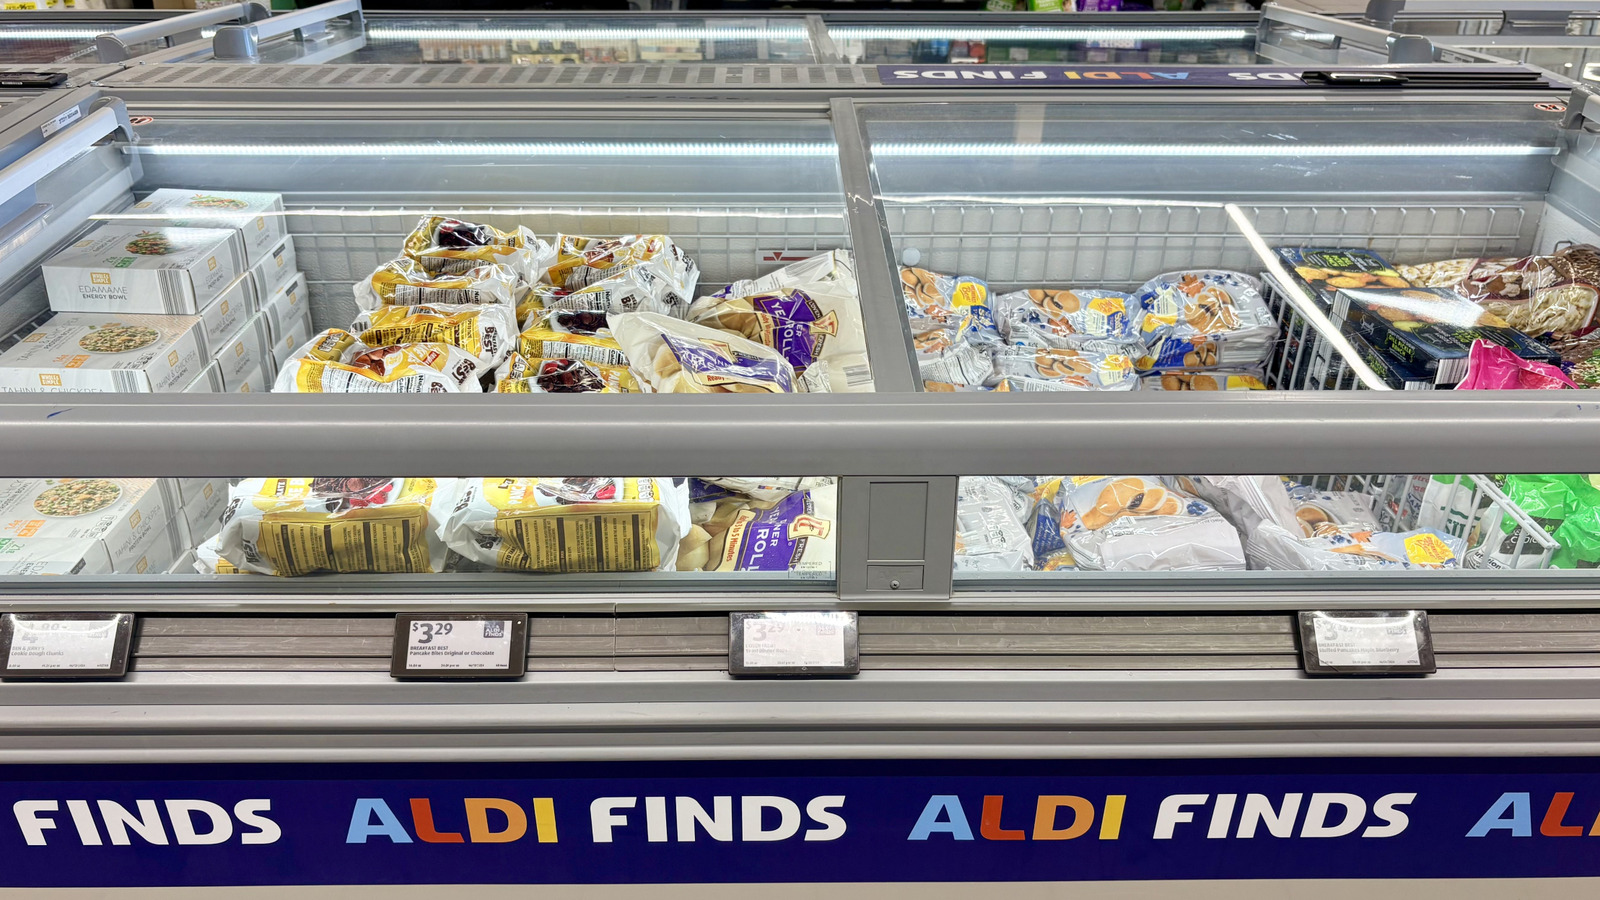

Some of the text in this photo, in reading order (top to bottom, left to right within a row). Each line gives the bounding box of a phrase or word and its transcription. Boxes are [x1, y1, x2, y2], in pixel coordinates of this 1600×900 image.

[893, 70, 1190, 80] ALDI FINDS
[78, 285, 128, 295] EDAMAME
[484, 326, 495, 356] BEST
[726, 538, 738, 562] Minutes
[794, 539, 806, 562] FRESH
[13, 799, 282, 846] FINDS
[345, 795, 848, 844] ALDI FINDS
[907, 792, 1418, 840] ALDI FINDS
[1465, 791, 1600, 838] AL
